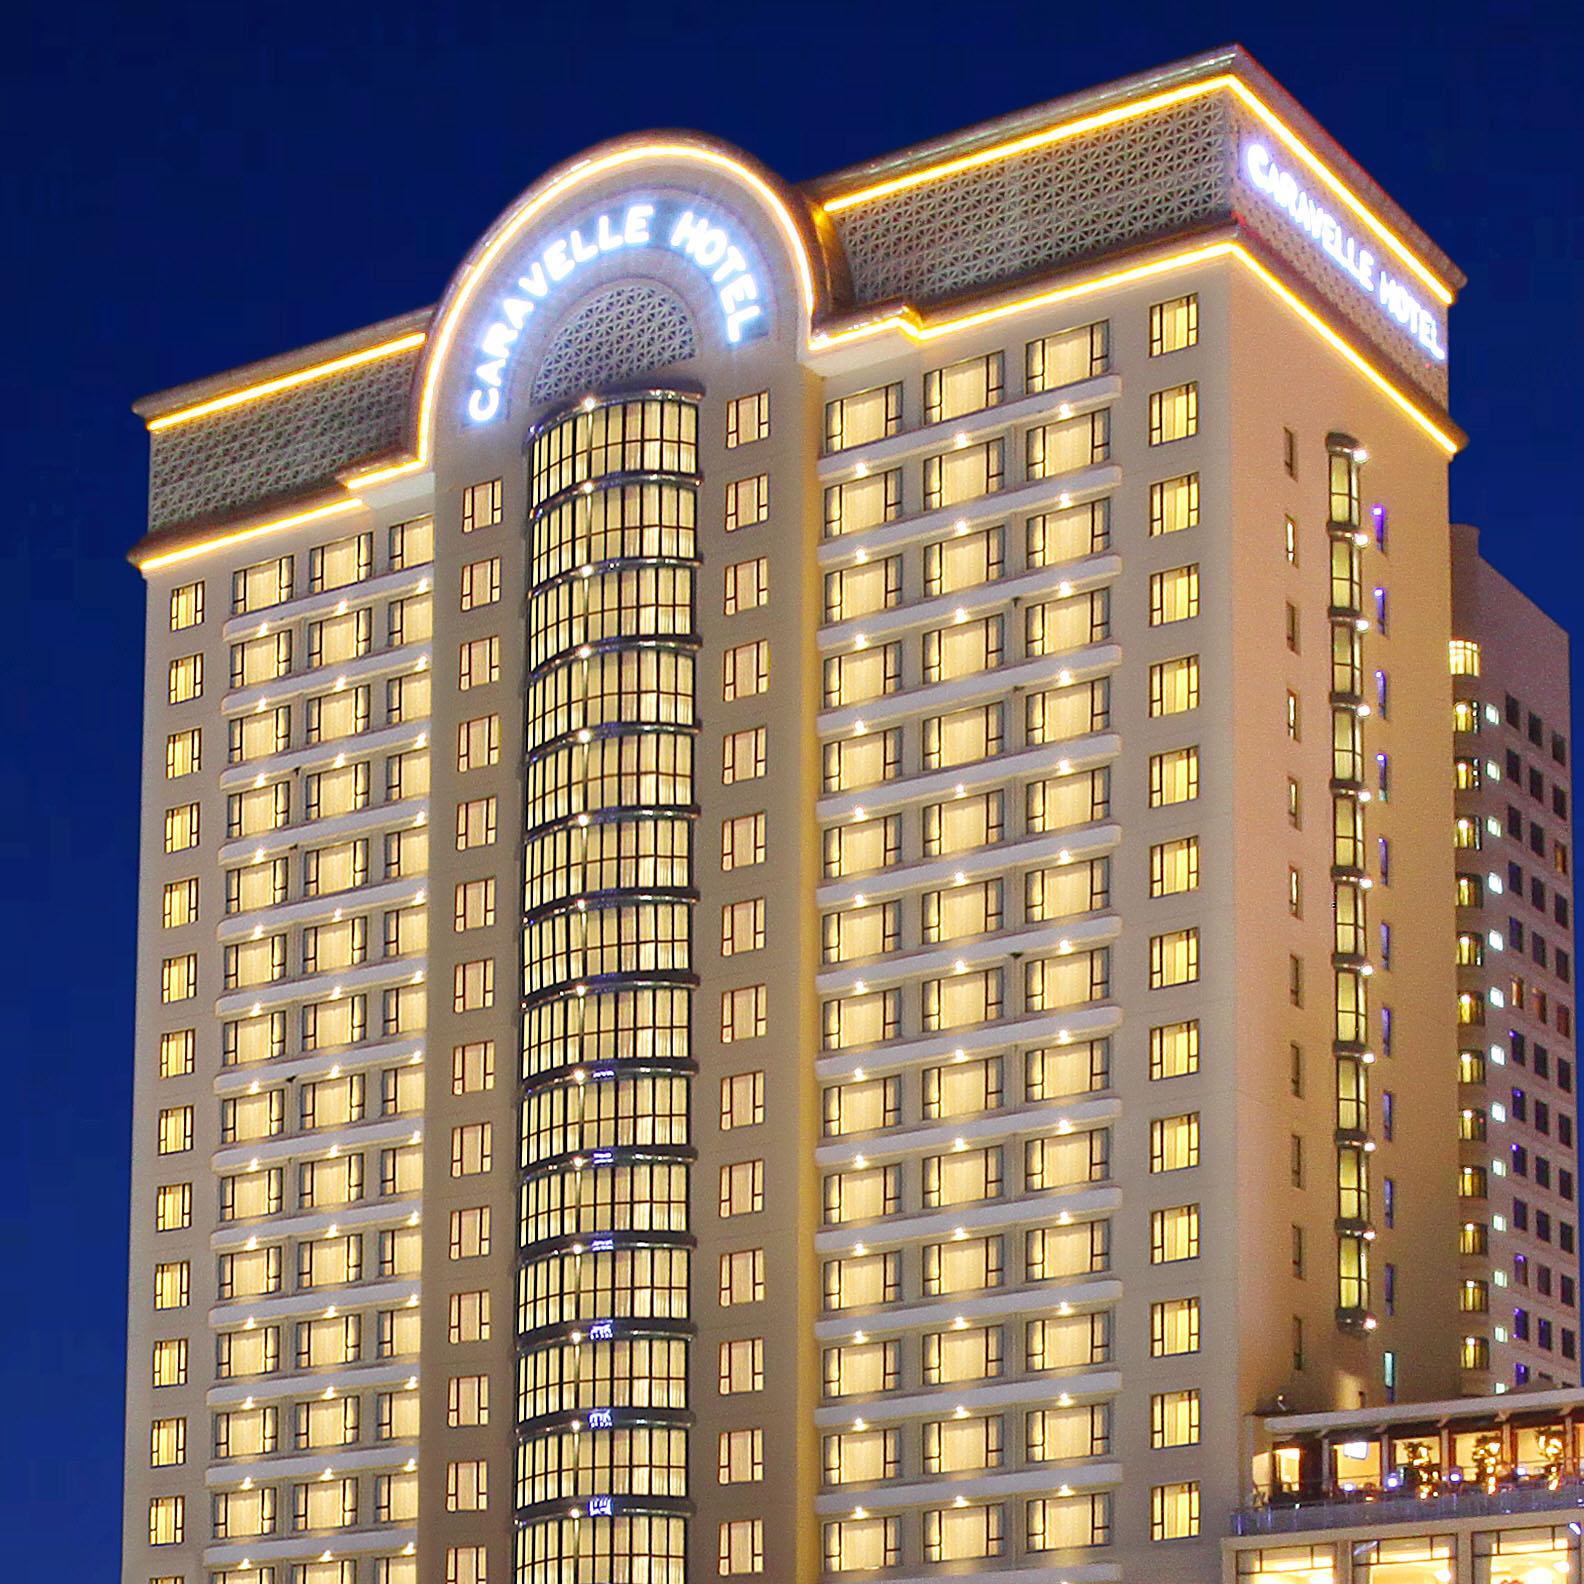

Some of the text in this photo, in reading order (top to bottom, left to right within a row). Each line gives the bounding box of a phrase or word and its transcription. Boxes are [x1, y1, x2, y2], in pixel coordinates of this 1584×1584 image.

[467, 204, 763, 423] CARAVELLE HOTEL
[1246, 143, 1446, 361] CARAVELLE HOTEL
